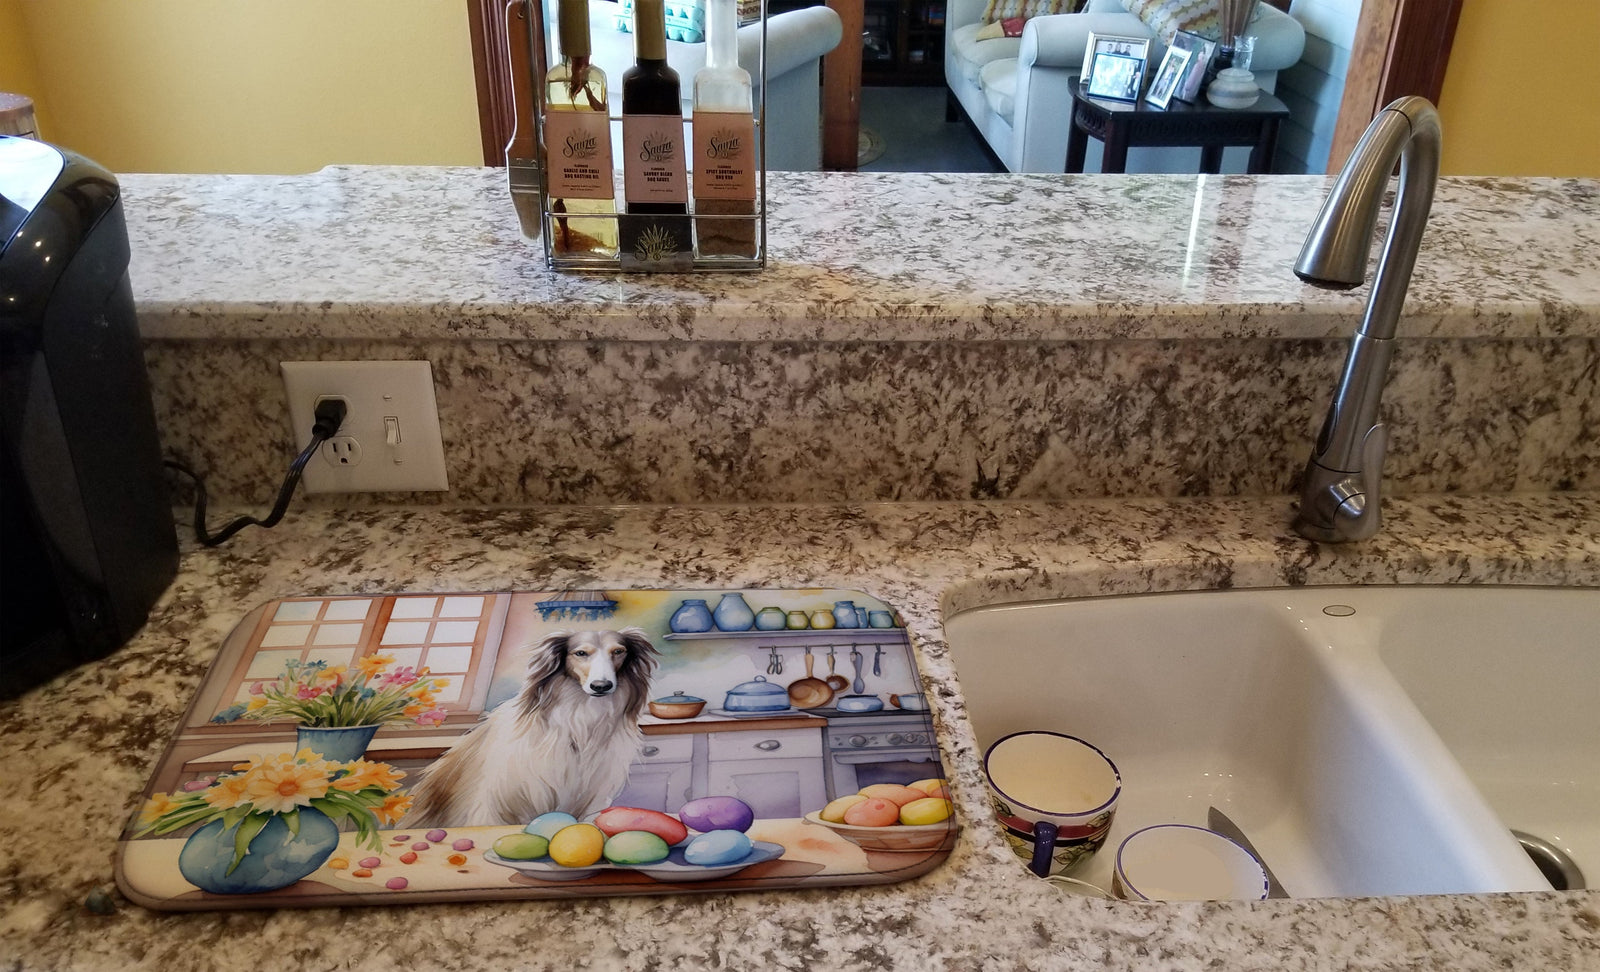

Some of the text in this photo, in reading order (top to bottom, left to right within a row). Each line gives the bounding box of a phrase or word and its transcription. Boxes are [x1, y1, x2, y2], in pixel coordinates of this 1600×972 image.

[562, 136, 597, 158] Sauza
[640, 140, 674, 162] Sauza
[706, 136, 741, 159] Sauza
